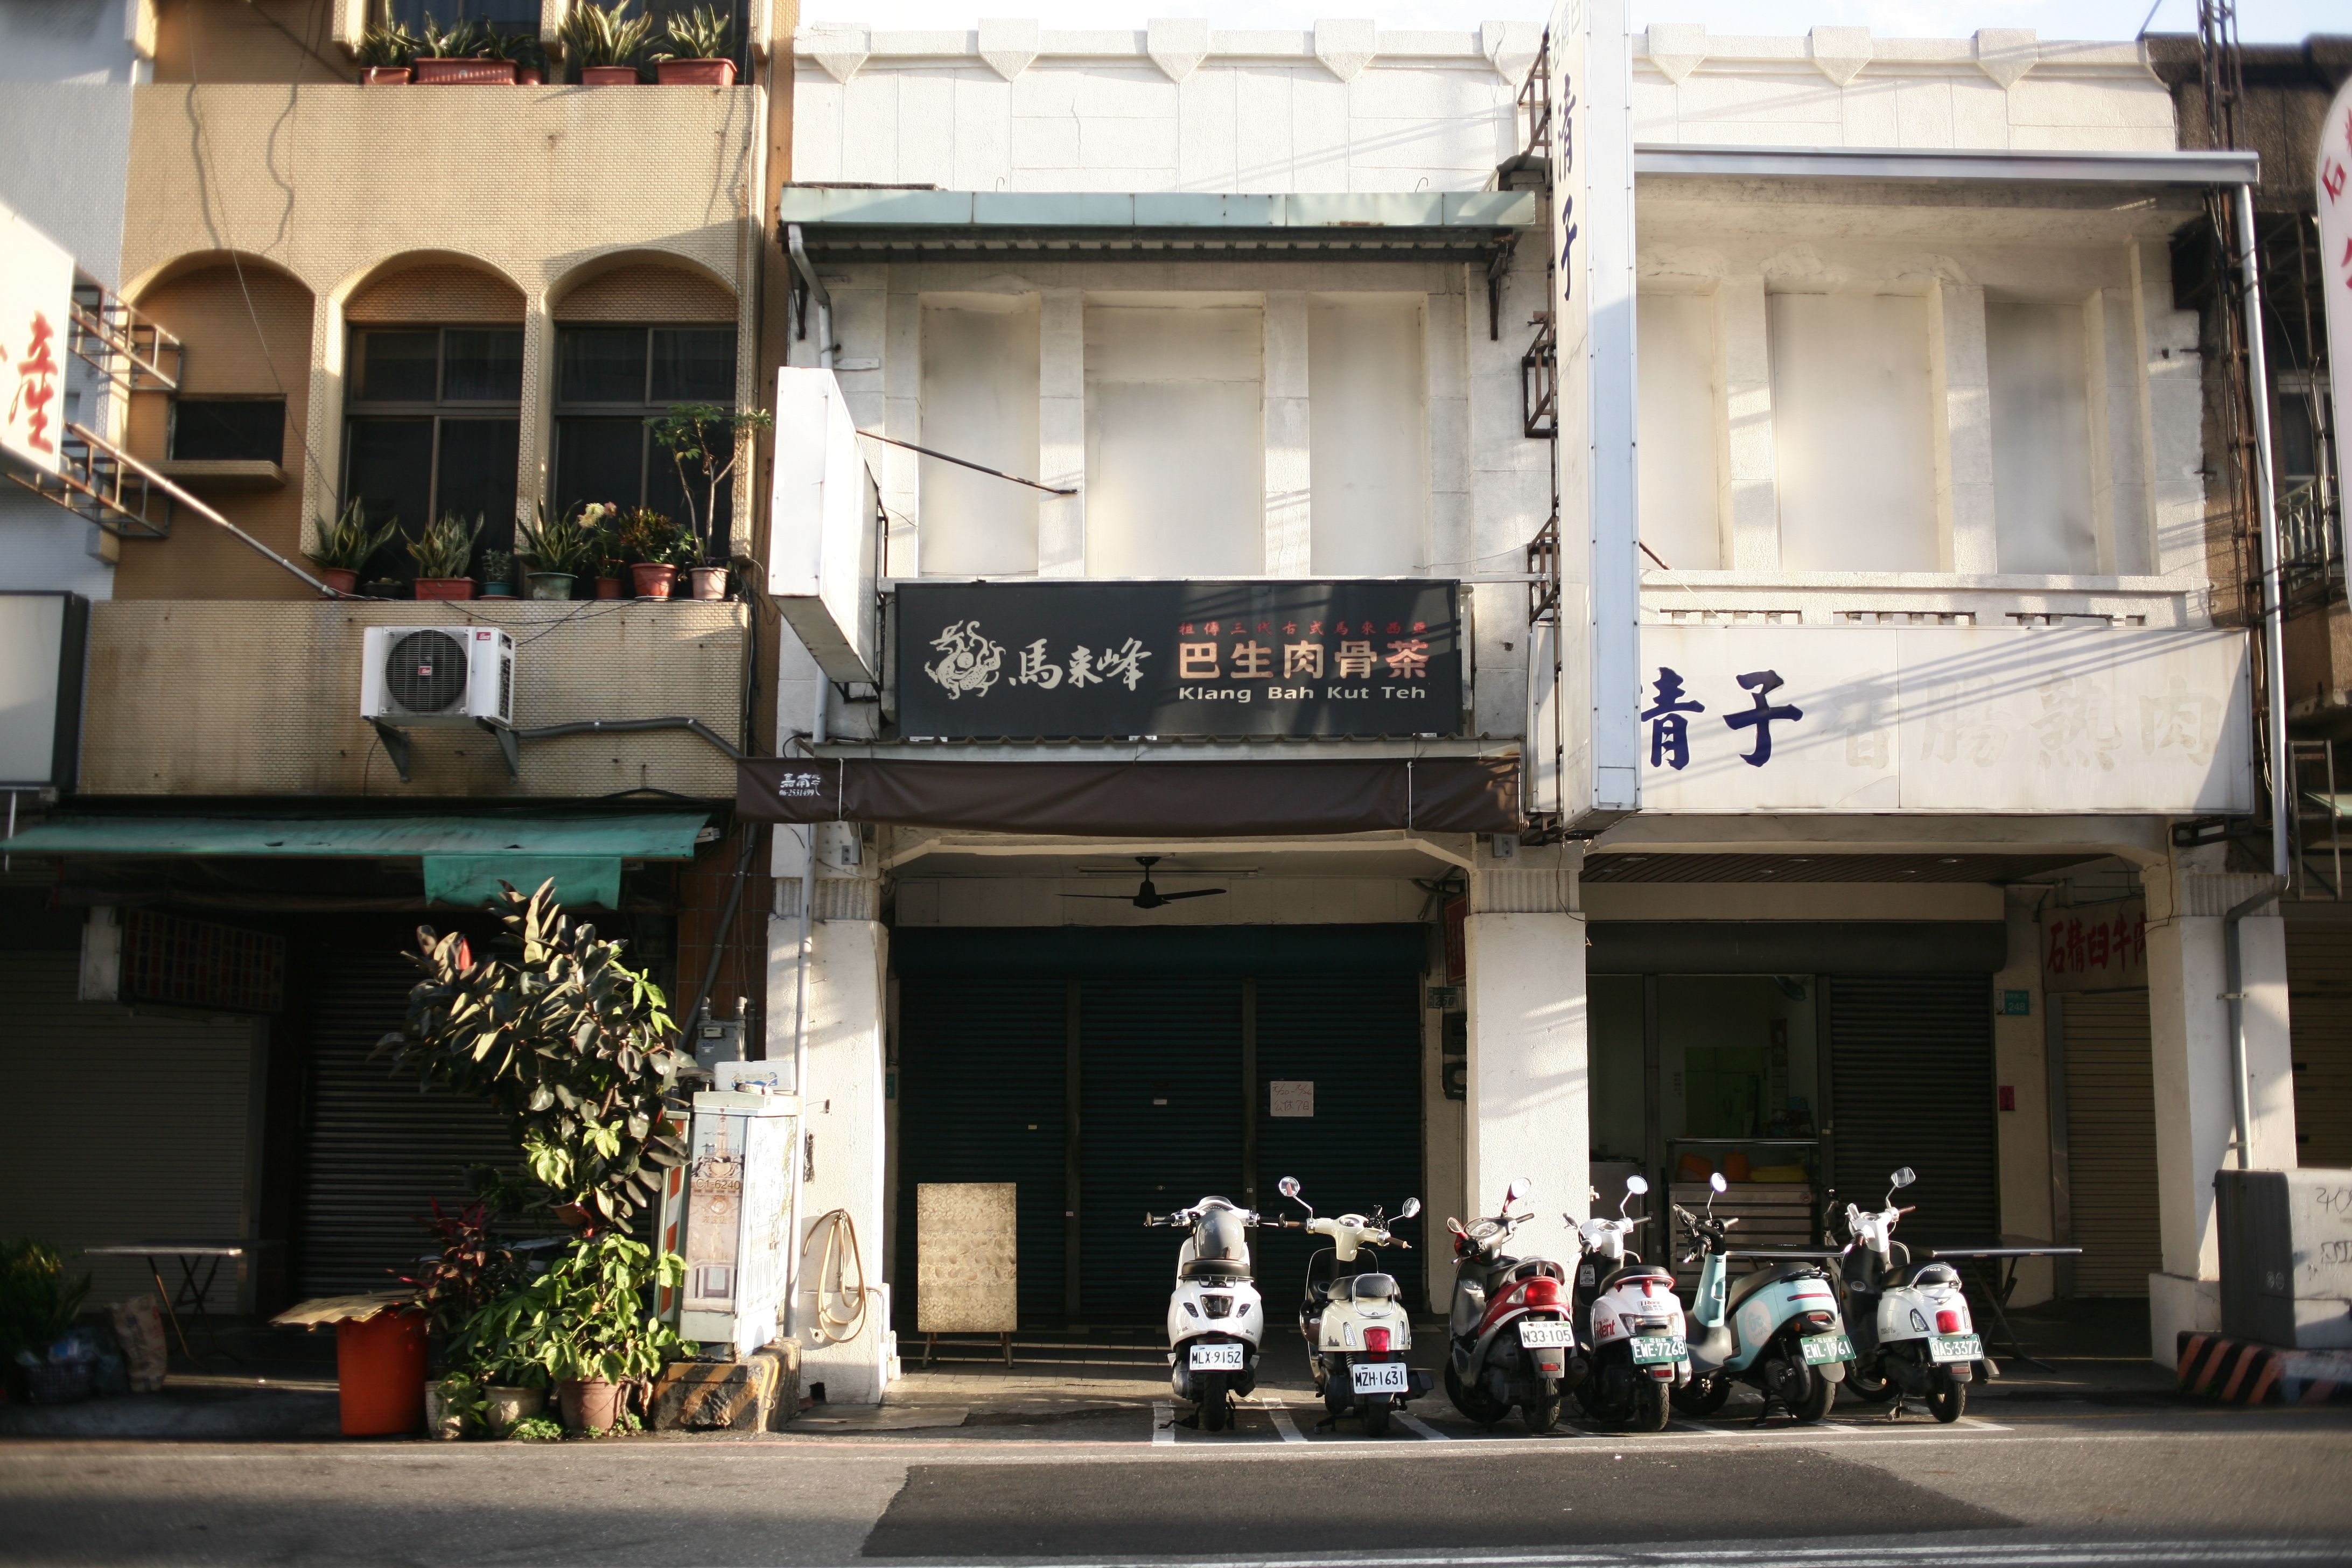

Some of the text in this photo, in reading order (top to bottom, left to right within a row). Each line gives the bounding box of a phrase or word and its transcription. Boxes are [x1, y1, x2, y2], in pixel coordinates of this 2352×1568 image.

[1557, 72, 1578, 302] 清子
[1179, 639, 1430, 679] 巴生肉骨茶
[1179, 687, 1426, 703] Klang Bah Kut Teh
[2008, 1002, 2025, 1011] 248
[696, 1178, 741, 1190] C1-6240
[1633, 1342, 1686, 1358] EWE-7268
[1804, 1341, 1851, 1359] EWL-1961
[1931, 1340, 1982, 1356] QAS-3372
[1192, 1350, 1241, 1364] MLX-9152
[1355, 1370, 1403, 1387] MZH-1631
